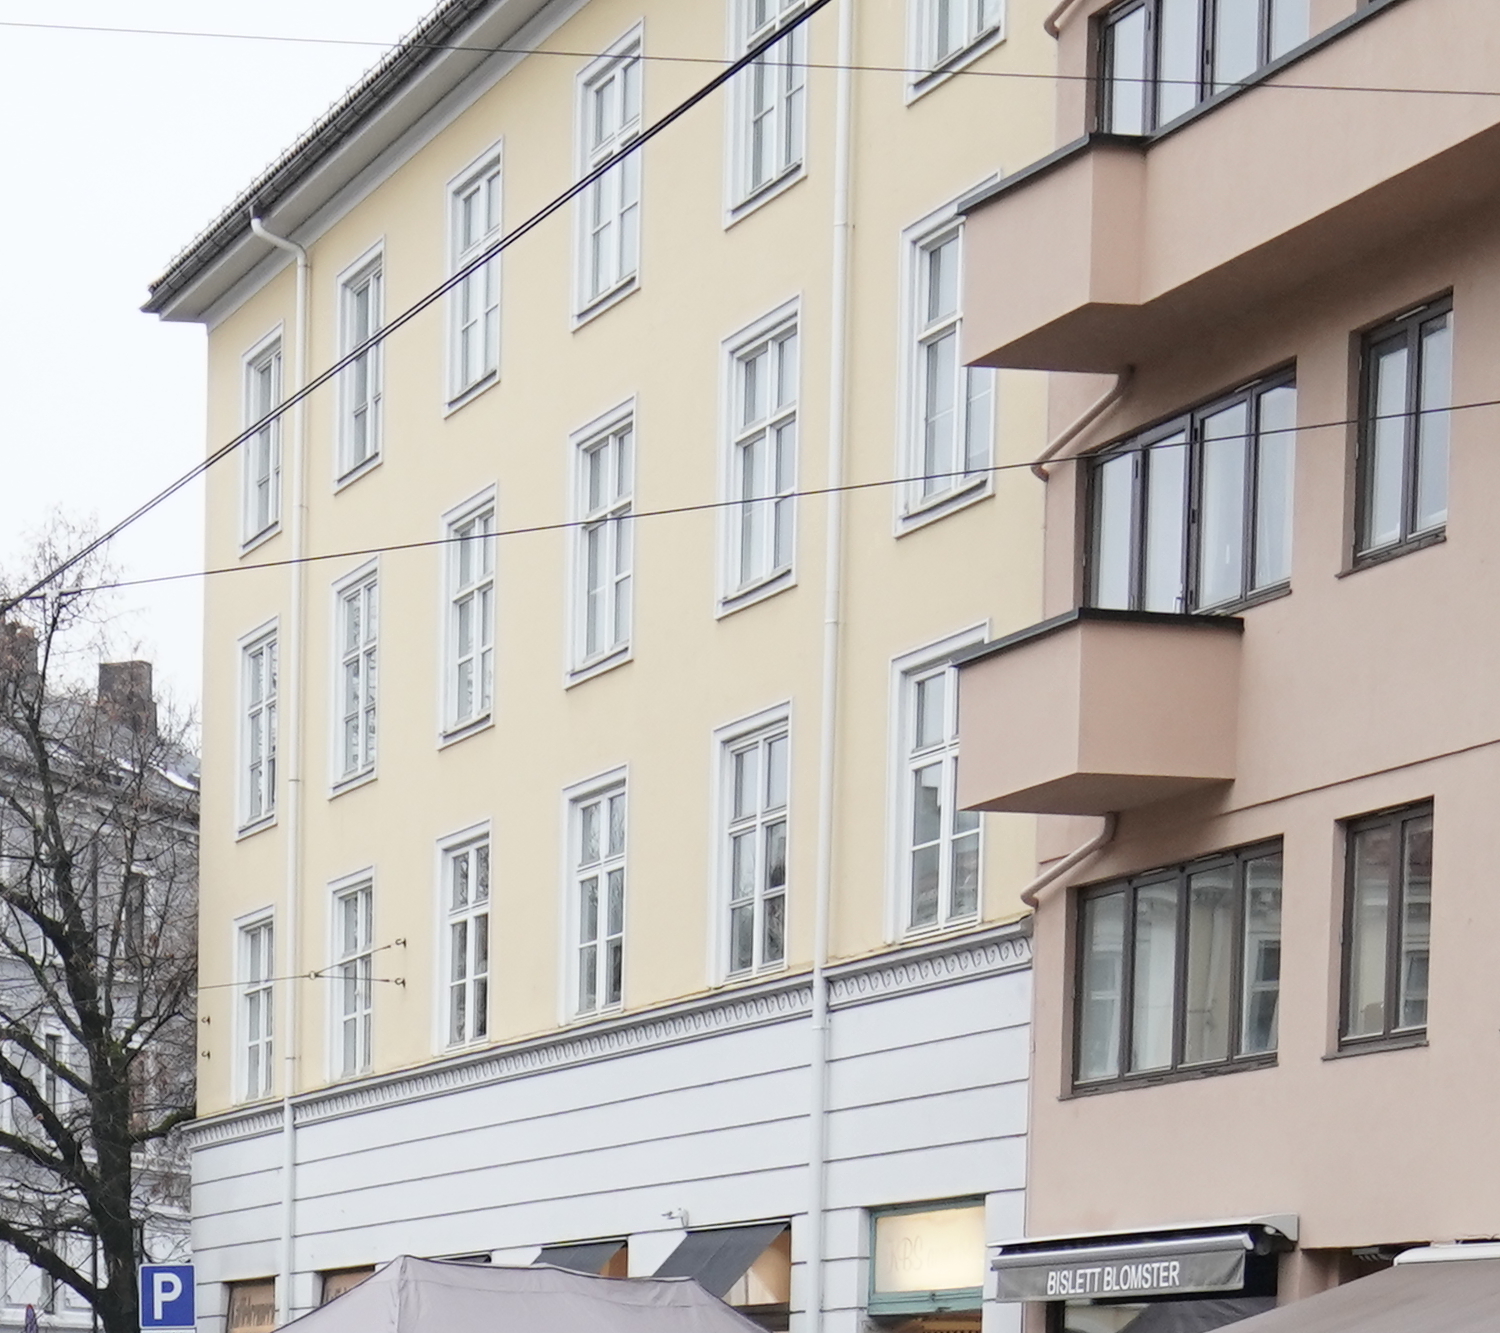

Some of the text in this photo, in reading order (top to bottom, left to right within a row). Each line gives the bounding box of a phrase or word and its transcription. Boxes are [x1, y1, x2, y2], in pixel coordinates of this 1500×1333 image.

[153, 1272, 182, 1320] P
[1047, 1261, 1180, 1295] BISLETT BLOMSTER
